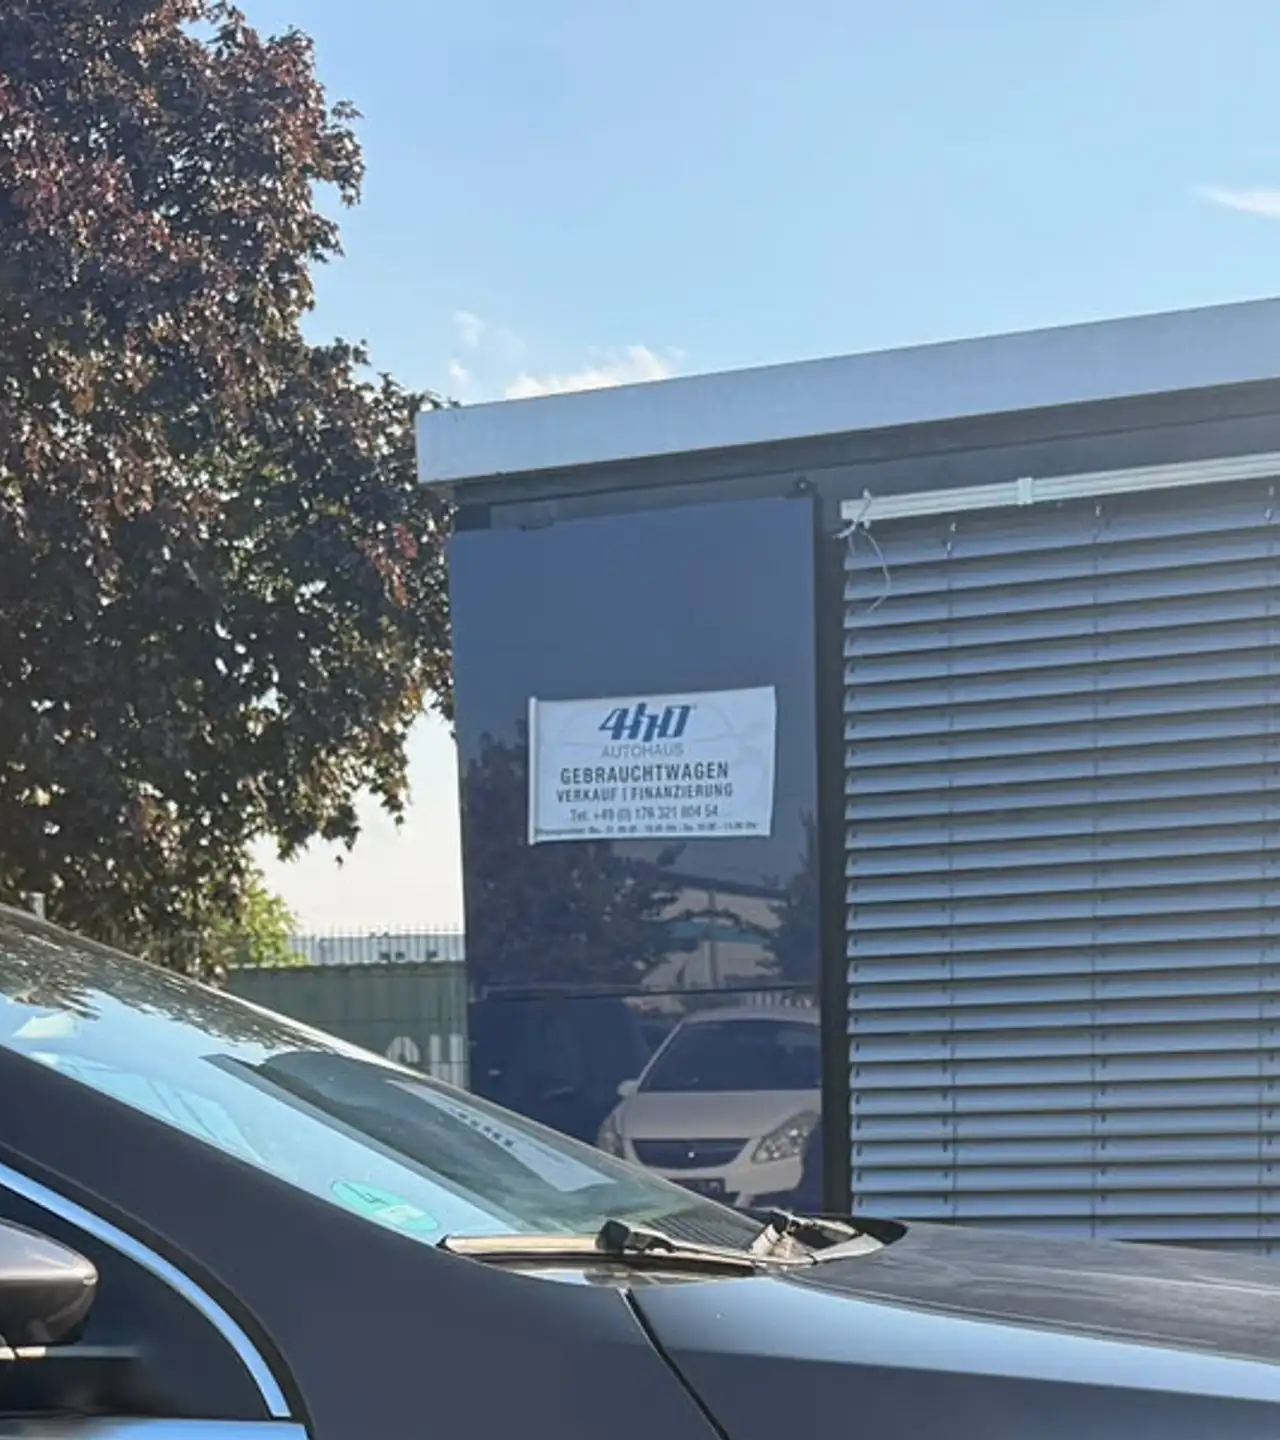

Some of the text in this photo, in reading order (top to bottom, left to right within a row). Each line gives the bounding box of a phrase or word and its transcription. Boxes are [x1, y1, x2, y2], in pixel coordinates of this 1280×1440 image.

[600, 743, 685, 759] AUTOHAUS
[560, 762, 729, 785] GEBRAUCHTWAGEN
[556, 786, 618, 803] VERKAUF
[630, 782, 733, 801] FINANZIERUNG
